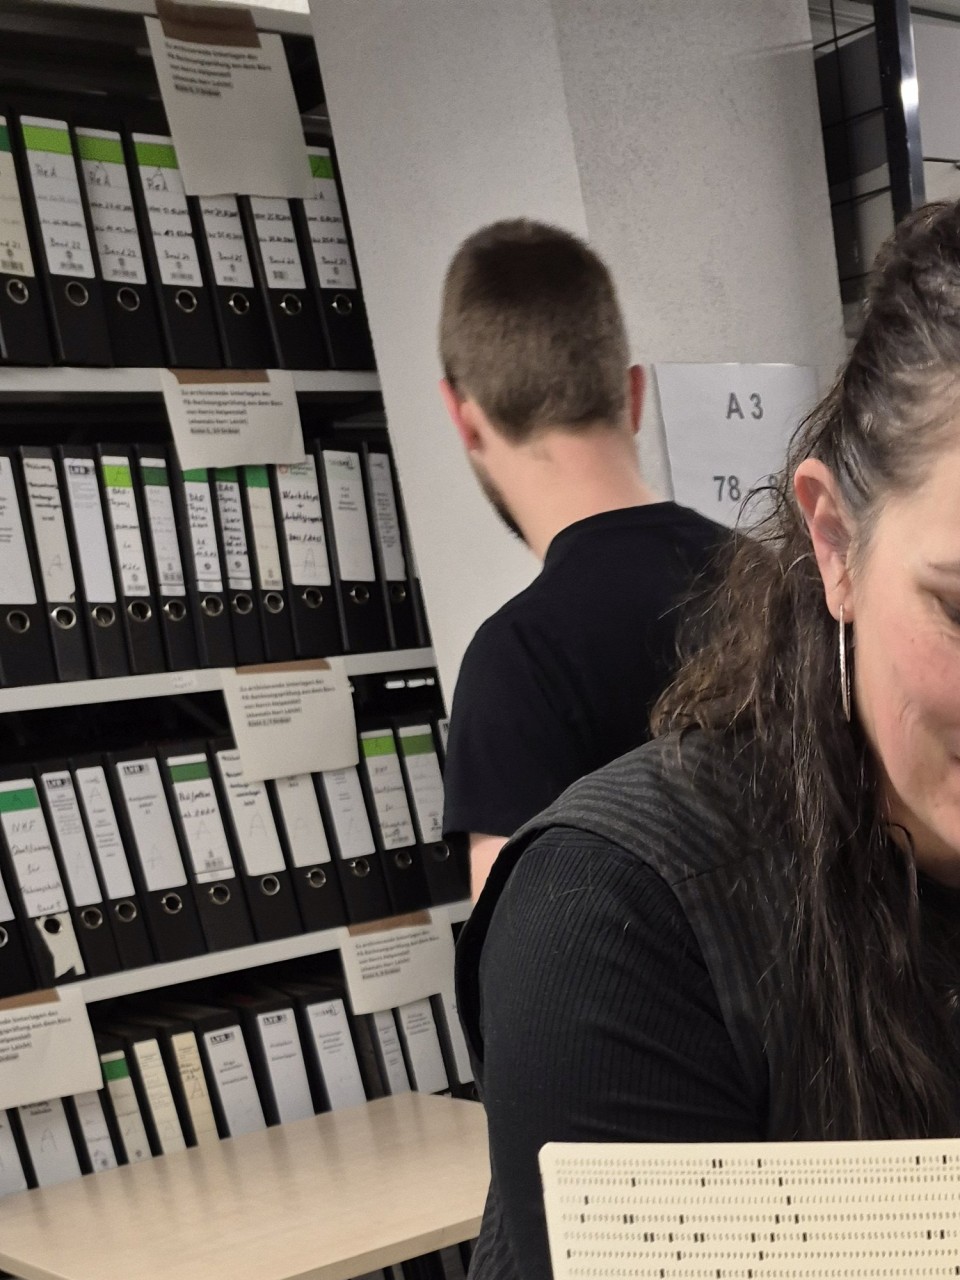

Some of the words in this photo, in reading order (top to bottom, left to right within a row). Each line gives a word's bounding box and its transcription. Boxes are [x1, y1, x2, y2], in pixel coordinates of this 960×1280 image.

[726, 392, 744, 420] A
[750, 393, 764, 420] 3
[713, 475, 741, 502] 78
